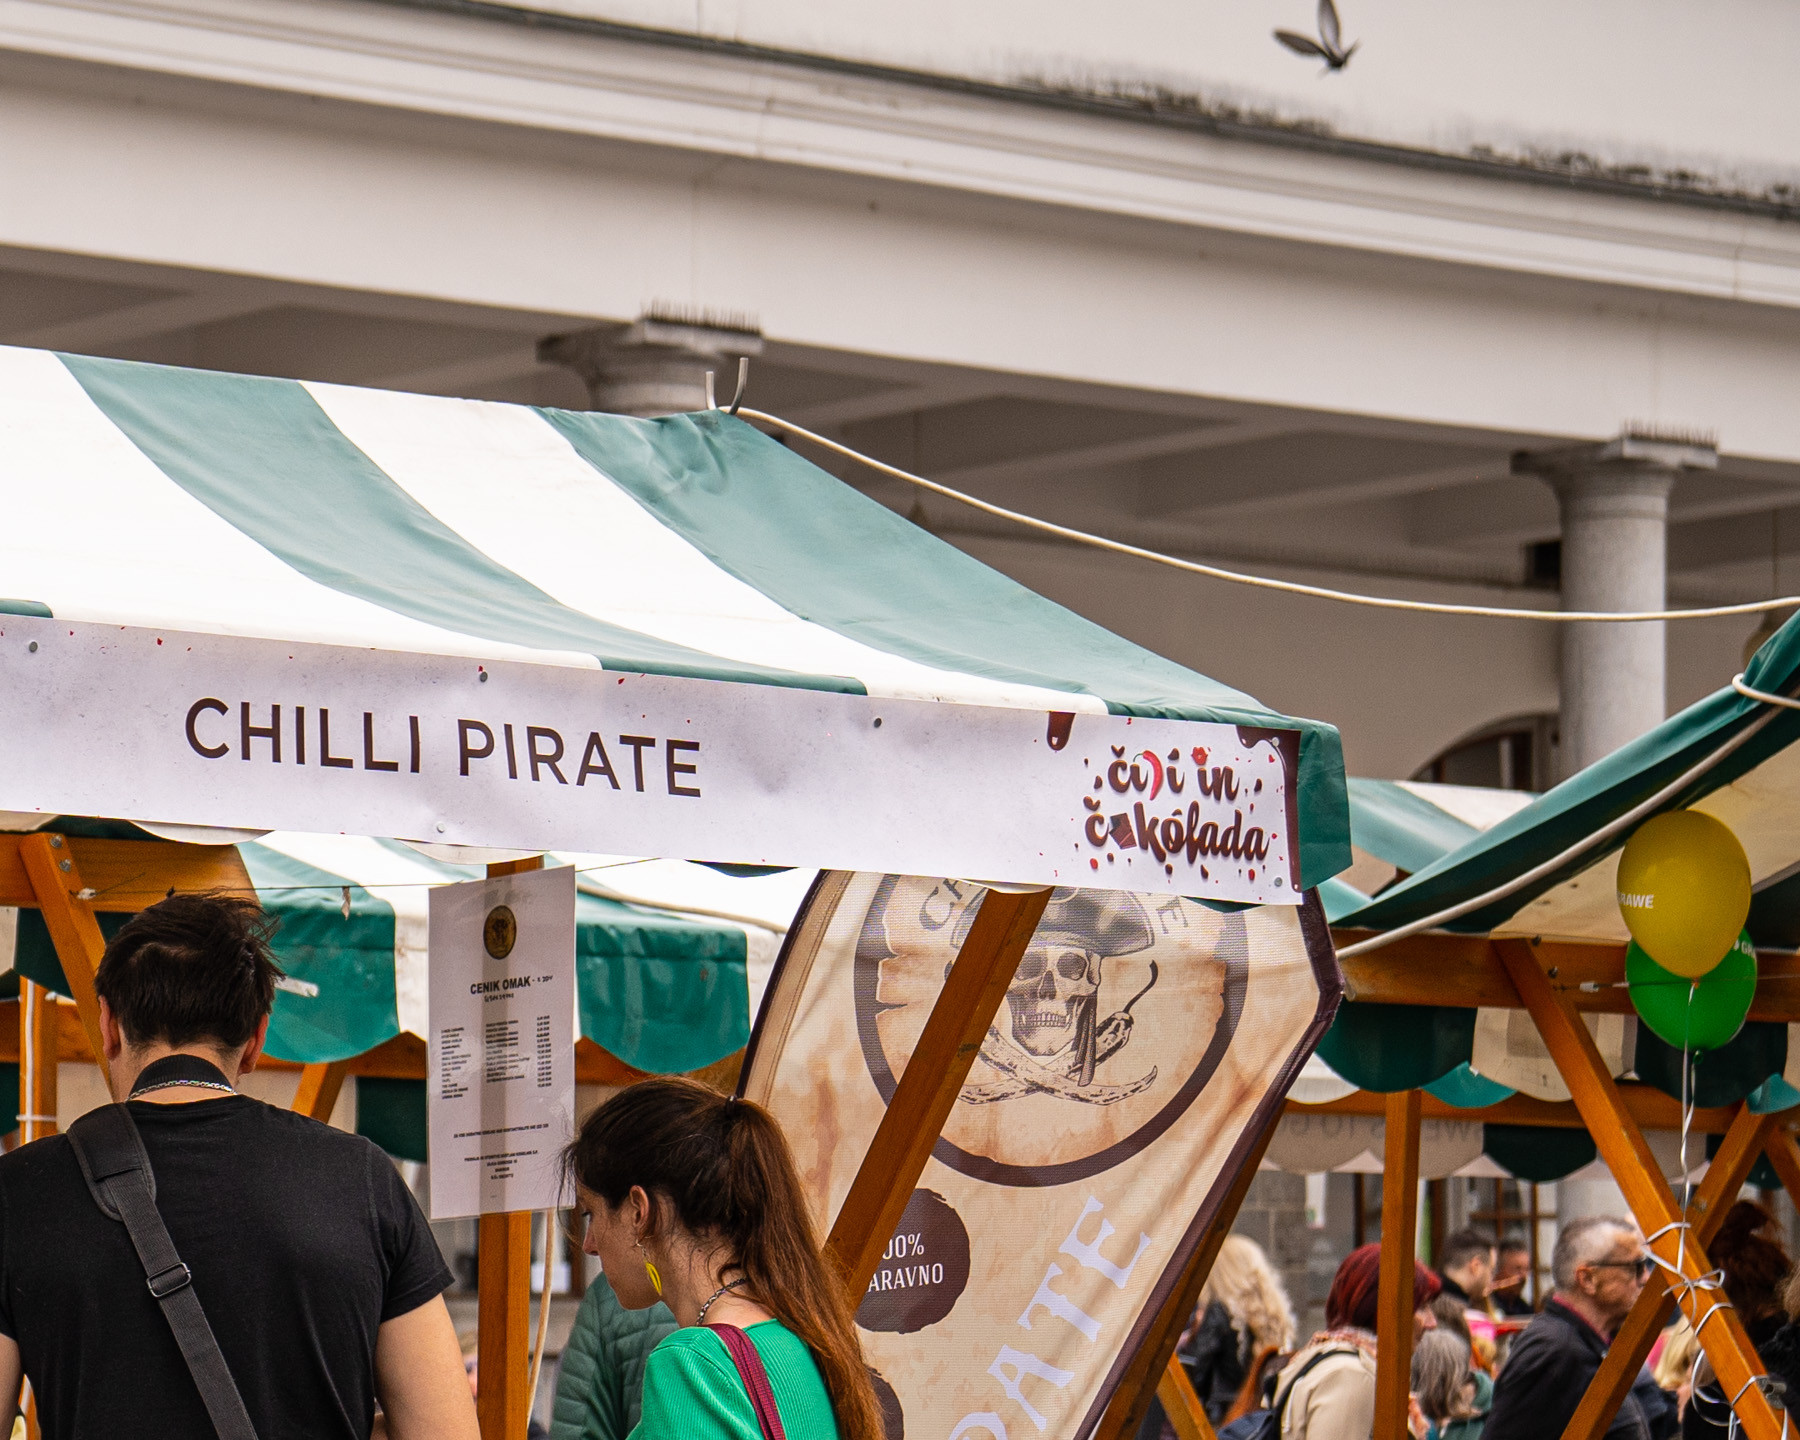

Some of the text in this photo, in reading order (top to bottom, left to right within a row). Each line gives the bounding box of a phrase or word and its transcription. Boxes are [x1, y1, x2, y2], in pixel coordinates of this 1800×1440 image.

[185, 697, 701, 797] CHILLI PIRATE
[1191, 746, 1240, 801] in
[470, 980, 500, 995] CENIK
[502, 976, 531, 990] OMAK
[867, 1263, 944, 1293] ARAVNO
